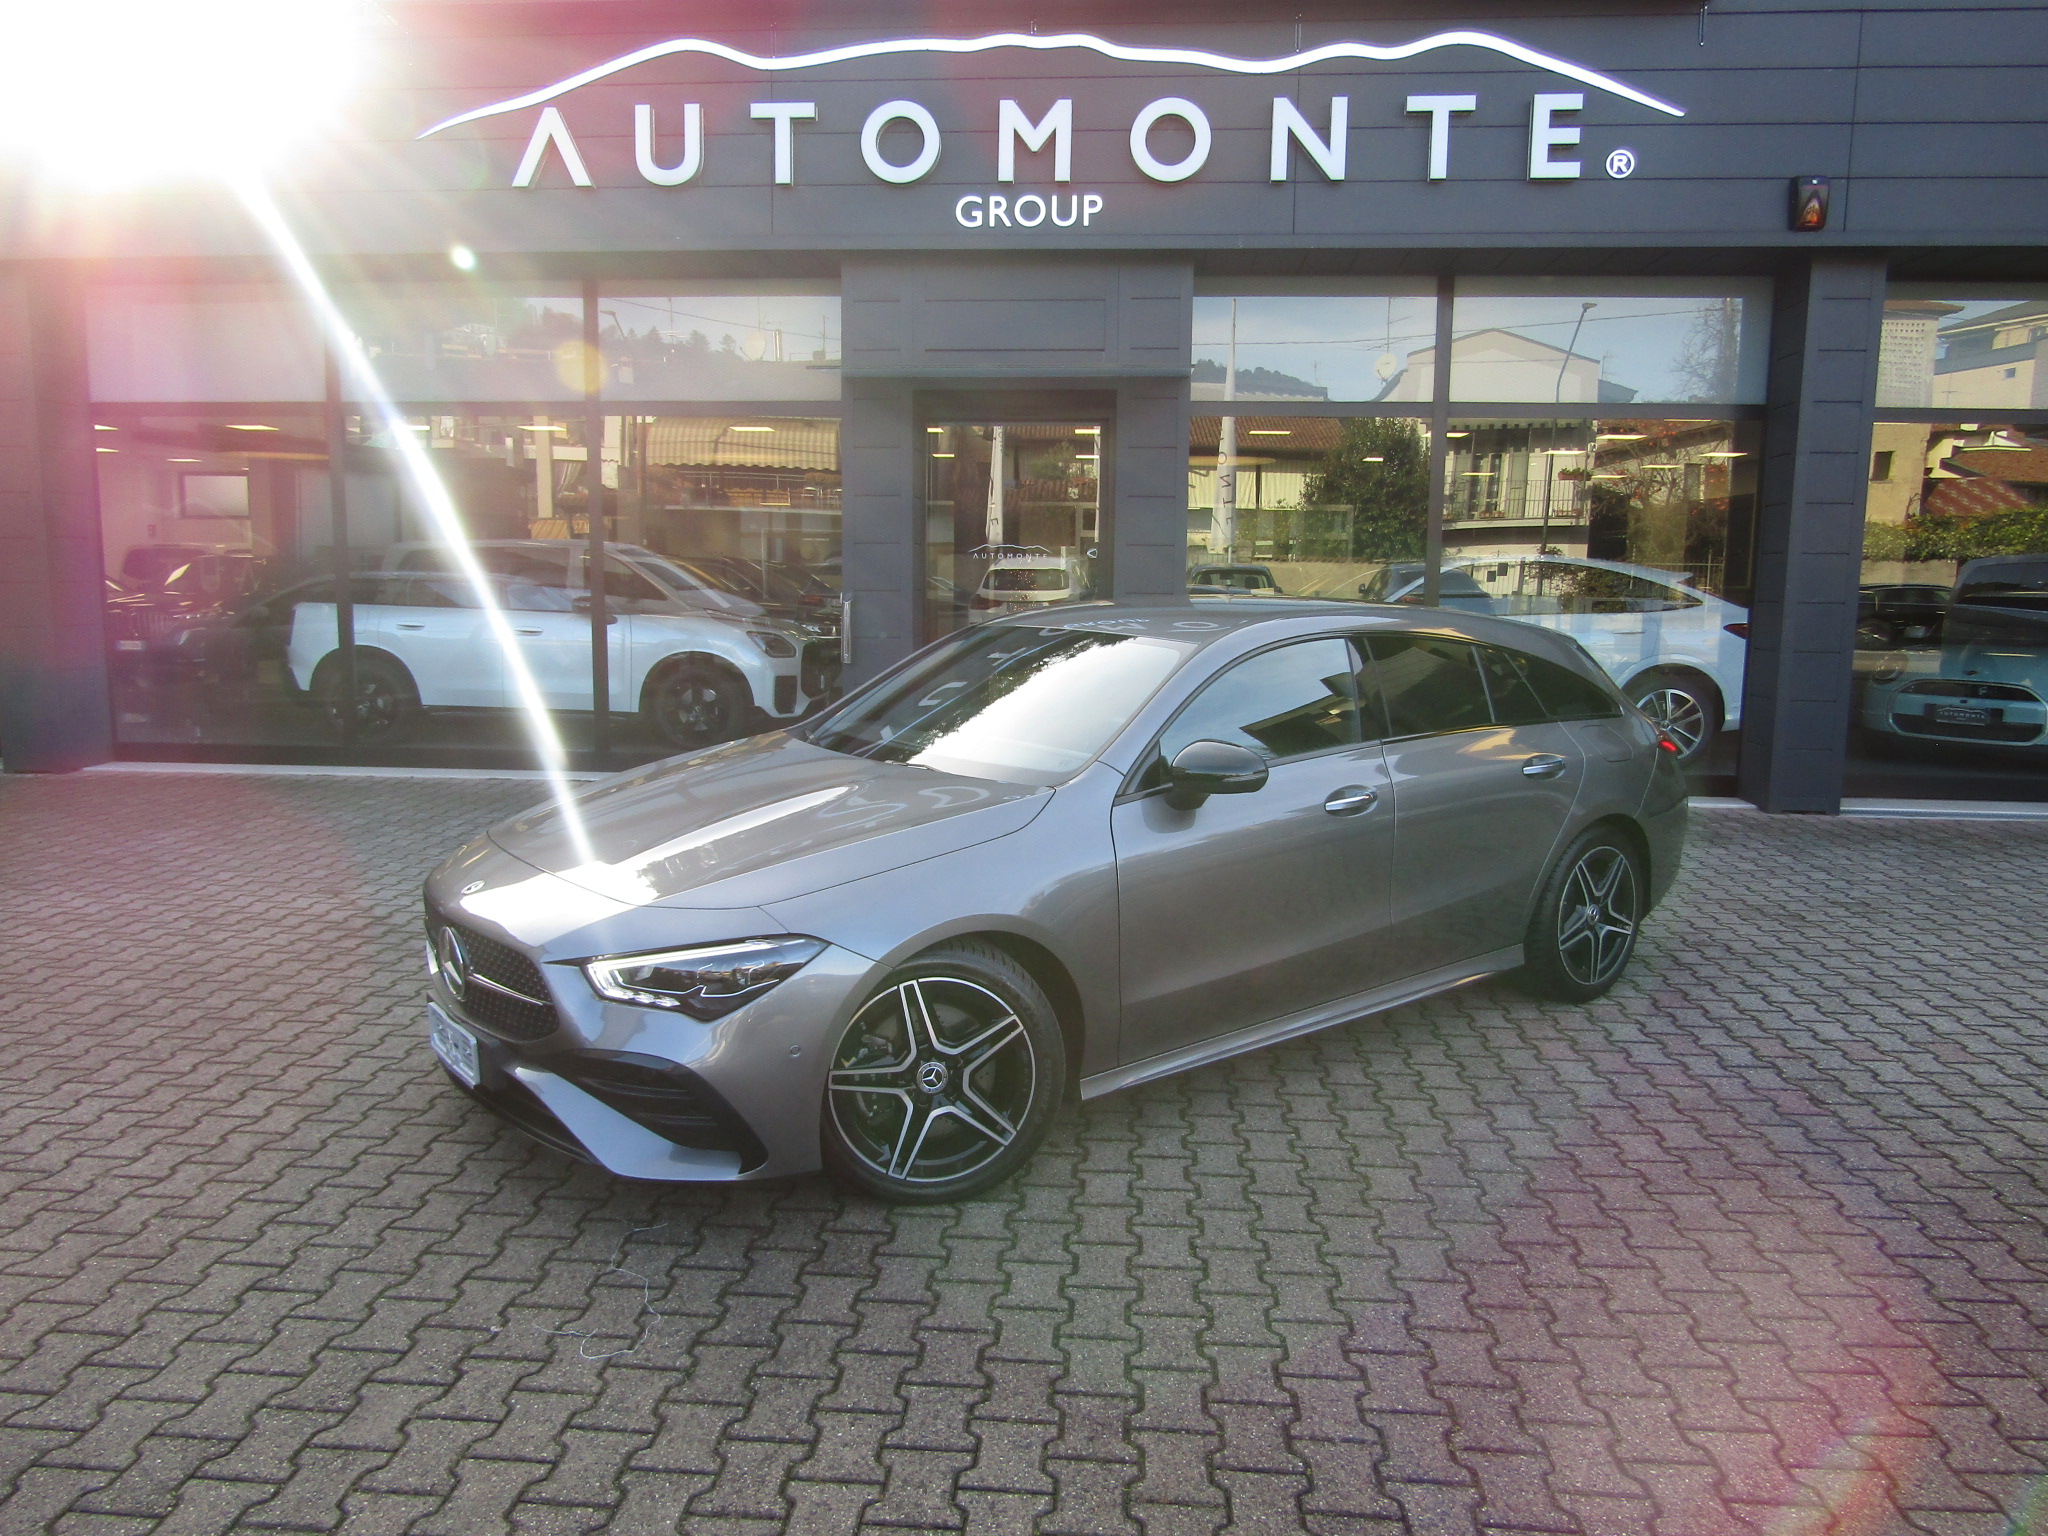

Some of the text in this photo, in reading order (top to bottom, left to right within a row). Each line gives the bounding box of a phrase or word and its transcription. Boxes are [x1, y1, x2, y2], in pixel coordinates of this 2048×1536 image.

[510, 93, 1585, 188] AUTOMONTE
[955, 193, 1104, 229] GROUP
[972, 552, 1048, 560] AUTOMONTE
